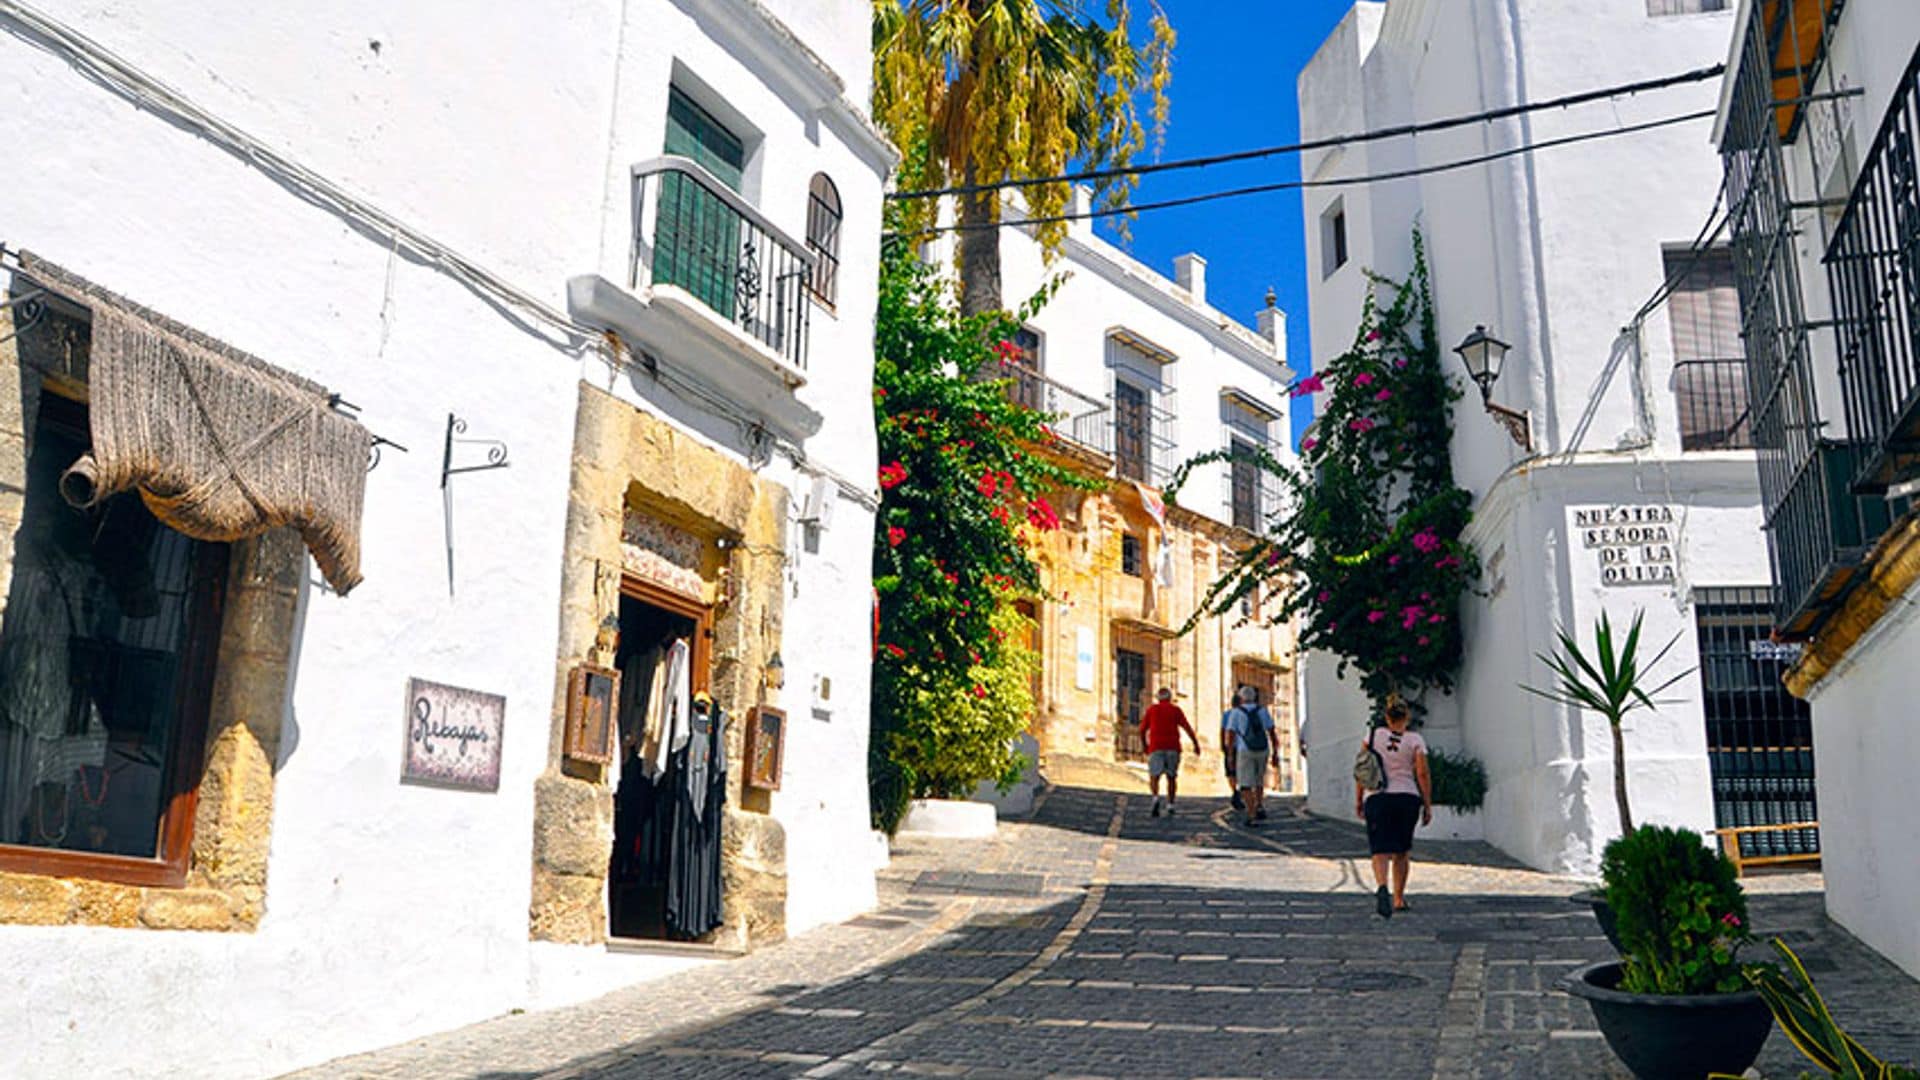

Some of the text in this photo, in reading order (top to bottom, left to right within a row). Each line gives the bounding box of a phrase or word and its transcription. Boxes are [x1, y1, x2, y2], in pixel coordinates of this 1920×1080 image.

[1587, 526, 1669, 545] SEÑORA
[1603, 545, 1671, 563] DE LA
[1605, 565, 1675, 582] OLIVA
[413, 696, 489, 756] Rebajas
